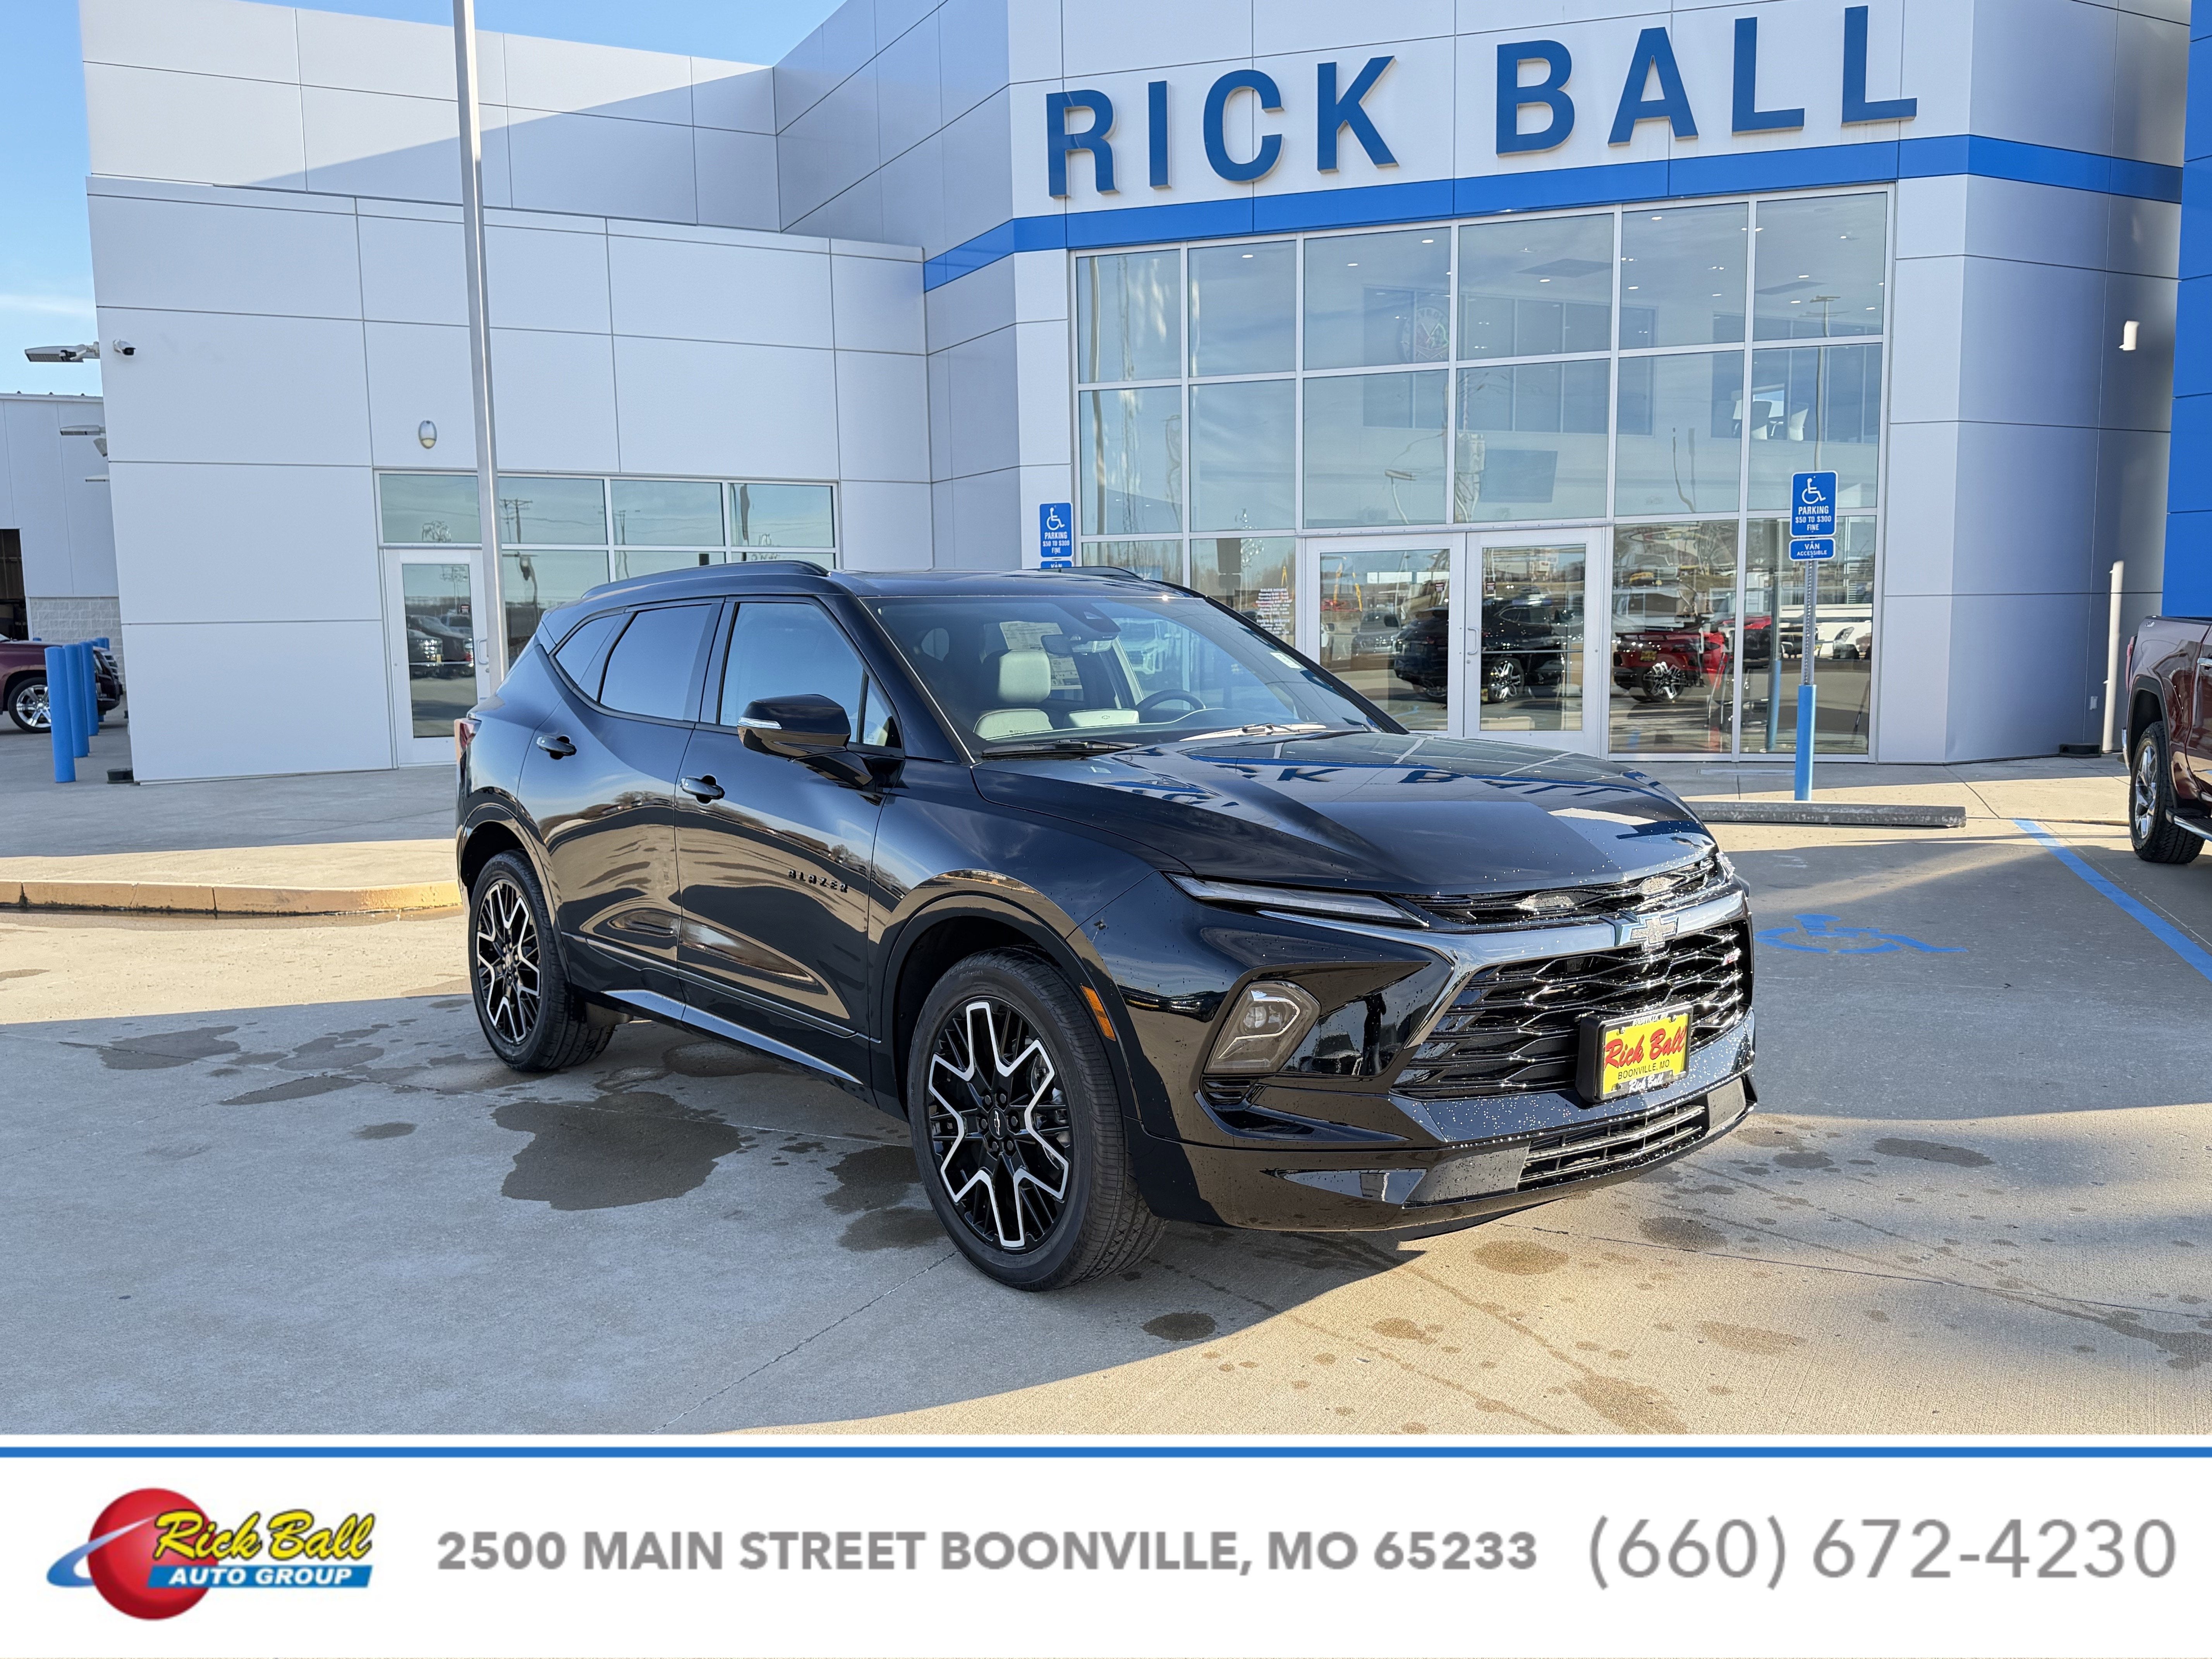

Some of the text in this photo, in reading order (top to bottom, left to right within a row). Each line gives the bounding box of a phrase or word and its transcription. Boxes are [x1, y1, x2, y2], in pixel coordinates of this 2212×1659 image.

[1046, 5, 1917, 199] RICK BALL
[1798, 505, 1829, 515] PARKING
[1044, 531, 1068, 540] PARKING
[788, 869, 848, 893] BLAZER
[1604, 1026, 1687, 1071] Rick Ball
[1659, 1059, 1670, 1070] MO
[1628, 1073, 1664, 1093] Rick Ball
